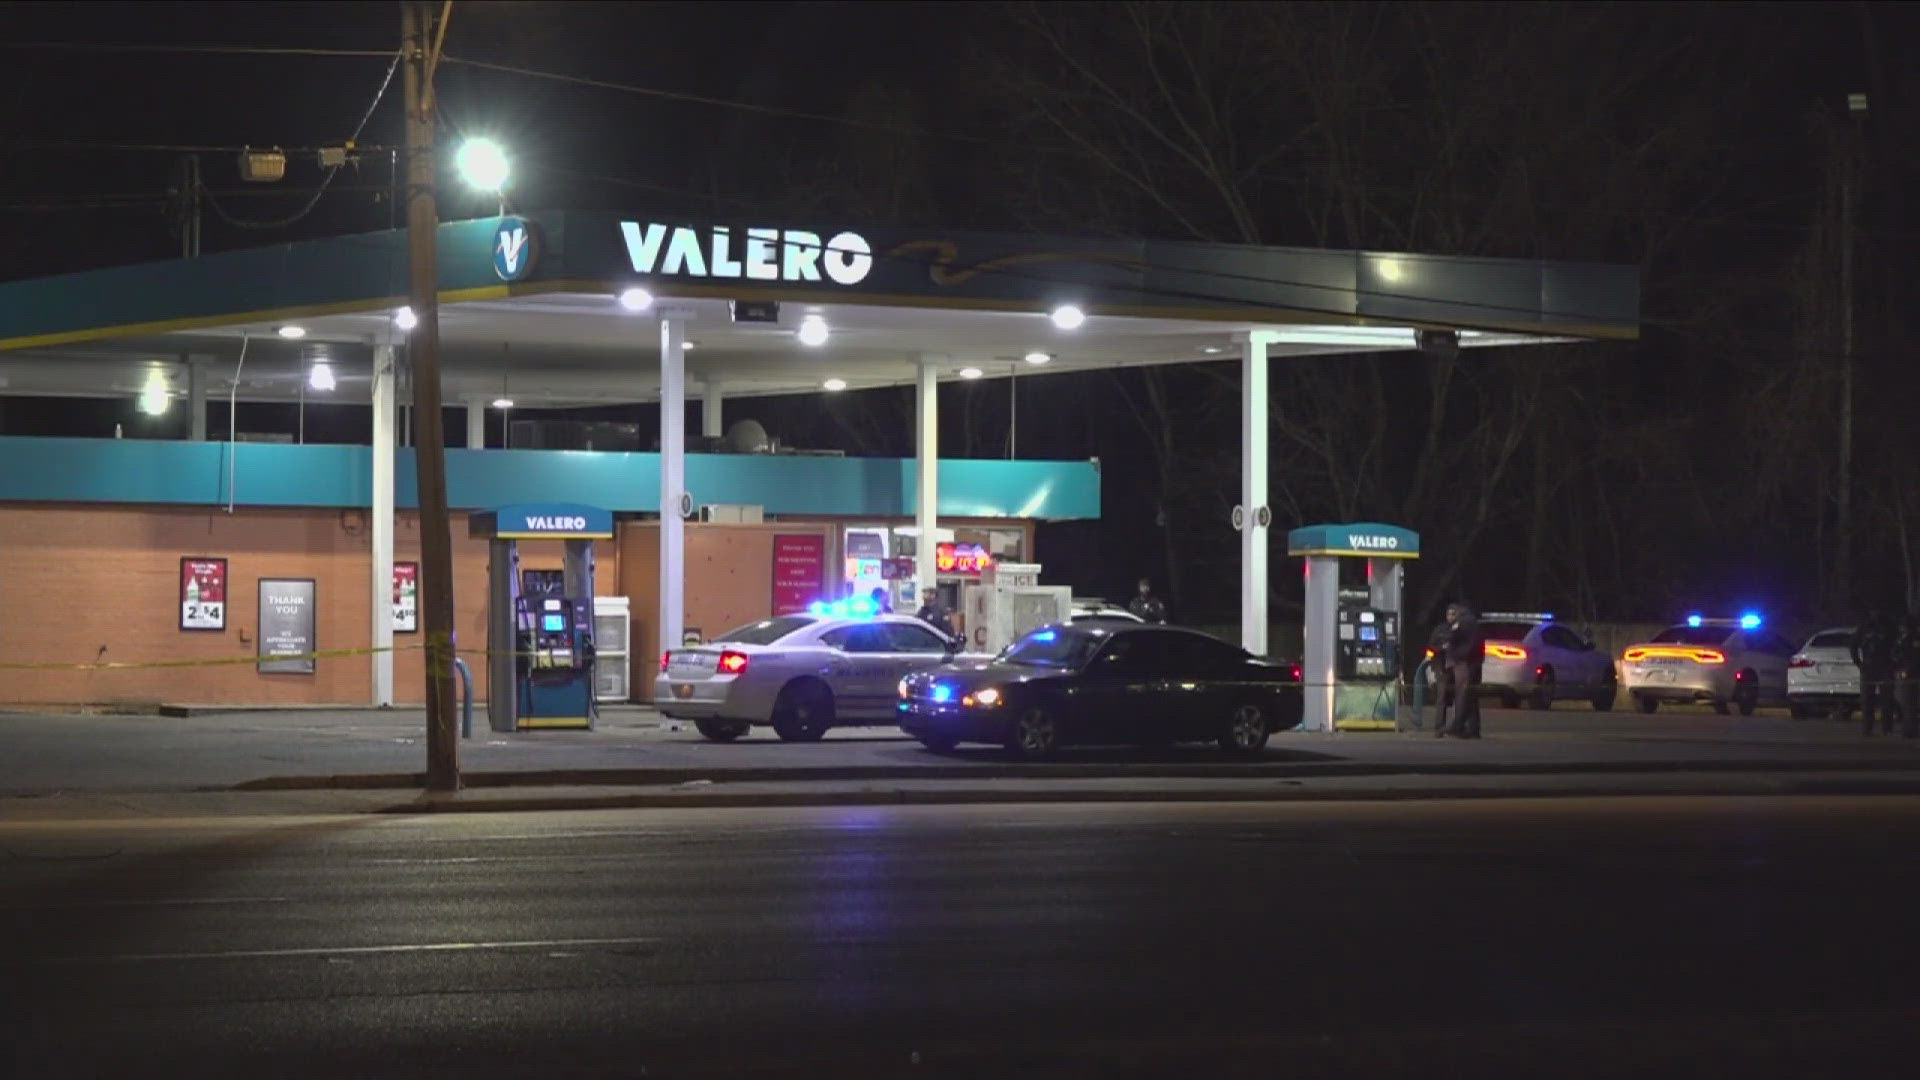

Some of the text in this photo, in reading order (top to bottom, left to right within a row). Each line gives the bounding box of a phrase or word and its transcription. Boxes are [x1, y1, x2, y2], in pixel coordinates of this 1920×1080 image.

[619, 221, 873, 285] VALERO
[525, 516, 586, 530] VALERO
[1349, 534, 1398, 549] VALERO
[1013, 575, 1034, 587] ICE
[268, 596, 305, 605] THANK
[275, 606, 298, 615] YOU
